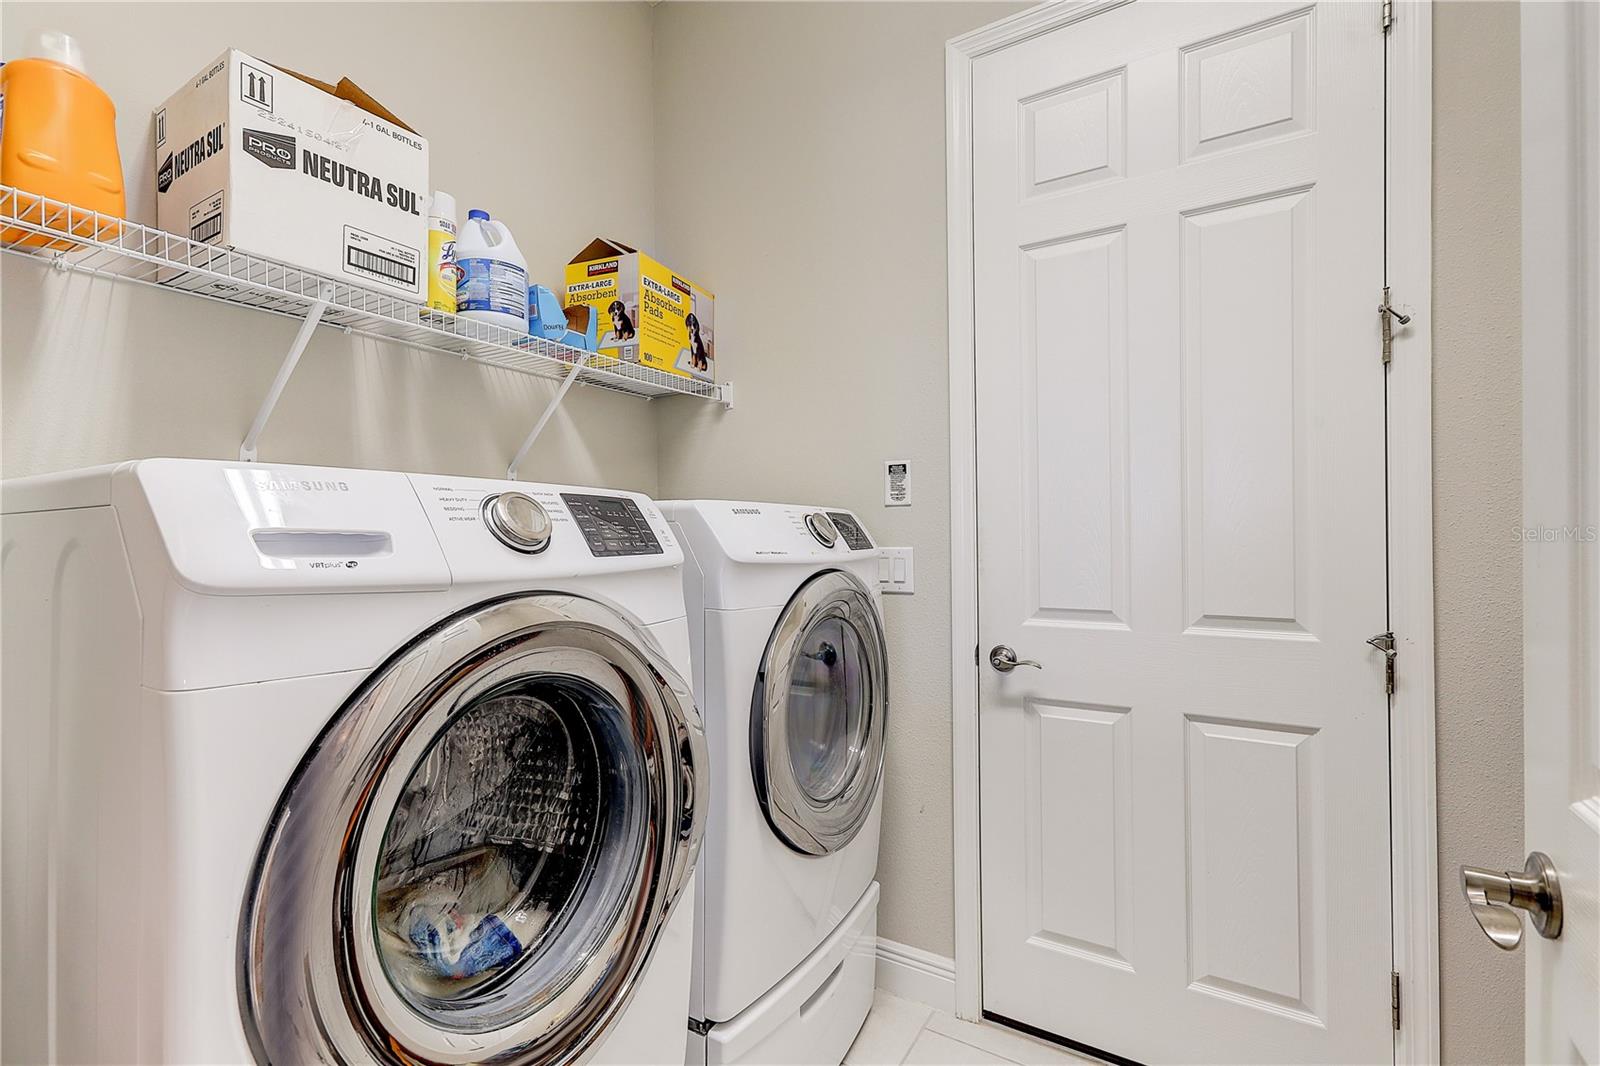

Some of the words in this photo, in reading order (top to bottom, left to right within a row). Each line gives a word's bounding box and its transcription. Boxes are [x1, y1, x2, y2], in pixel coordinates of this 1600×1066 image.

[375, 124, 391, 137] GAL
[392, 132, 423, 151] BOTTLES
[174, 136, 206, 180] NEUTRA
[206, 124, 224, 158] SUL
[248, 136, 292, 160] PRO
[248, 146, 292, 166] PRODUCTS
[303, 149, 383, 203] NEUTRA
[386, 183, 420, 217] SUL
[588, 261, 618, 272] KIRKLAND
[568, 279, 612, 293] EXTRA-LARGE
[568, 288, 617, 304] Absorbent
[643, 276, 681, 303] EXTRA-LARGE
[643, 289, 685, 318] Absorbent
[643, 301, 664, 320] Pads
[543, 323, 565, 331] Downy
[255, 480, 350, 492] SAMSUNG
